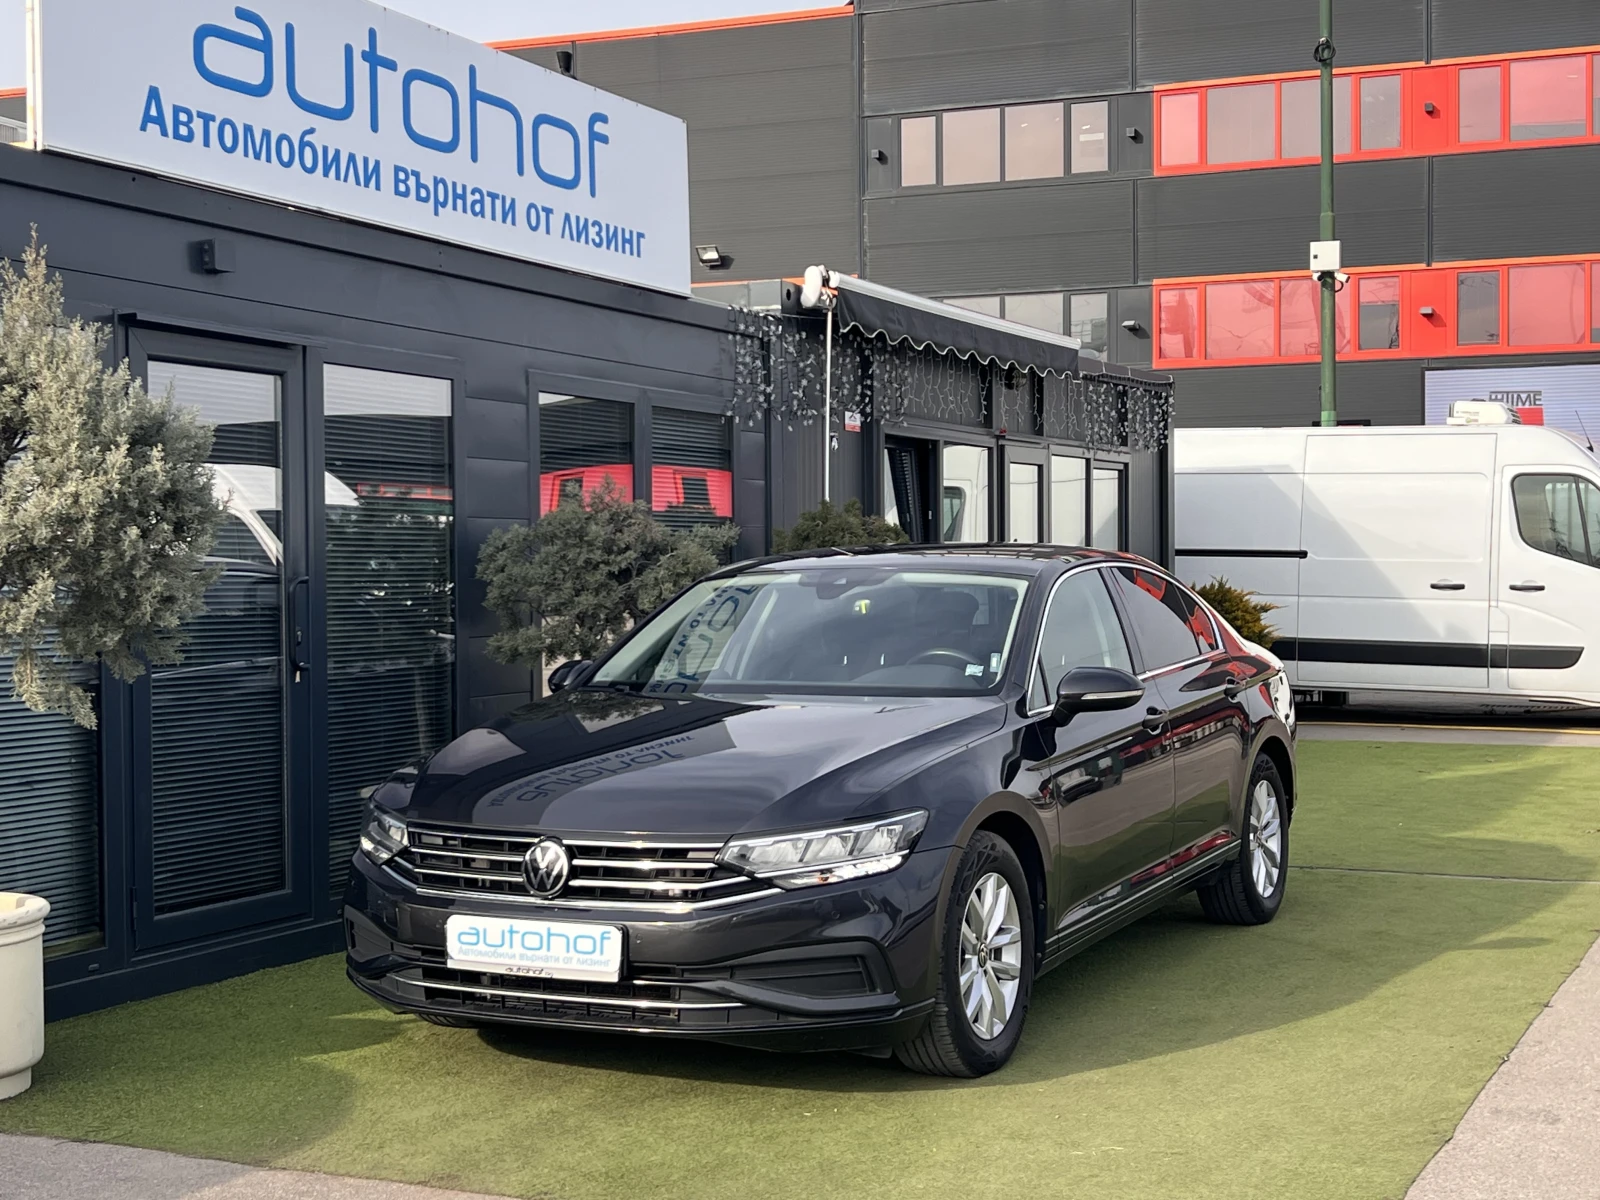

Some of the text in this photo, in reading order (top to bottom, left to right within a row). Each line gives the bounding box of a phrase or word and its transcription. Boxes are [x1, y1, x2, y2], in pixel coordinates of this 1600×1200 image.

[139, 85, 646, 259] Автомобили върнати от лизинг
[193, 6, 610, 198] autohof
[457, 924, 612, 956] autohof
